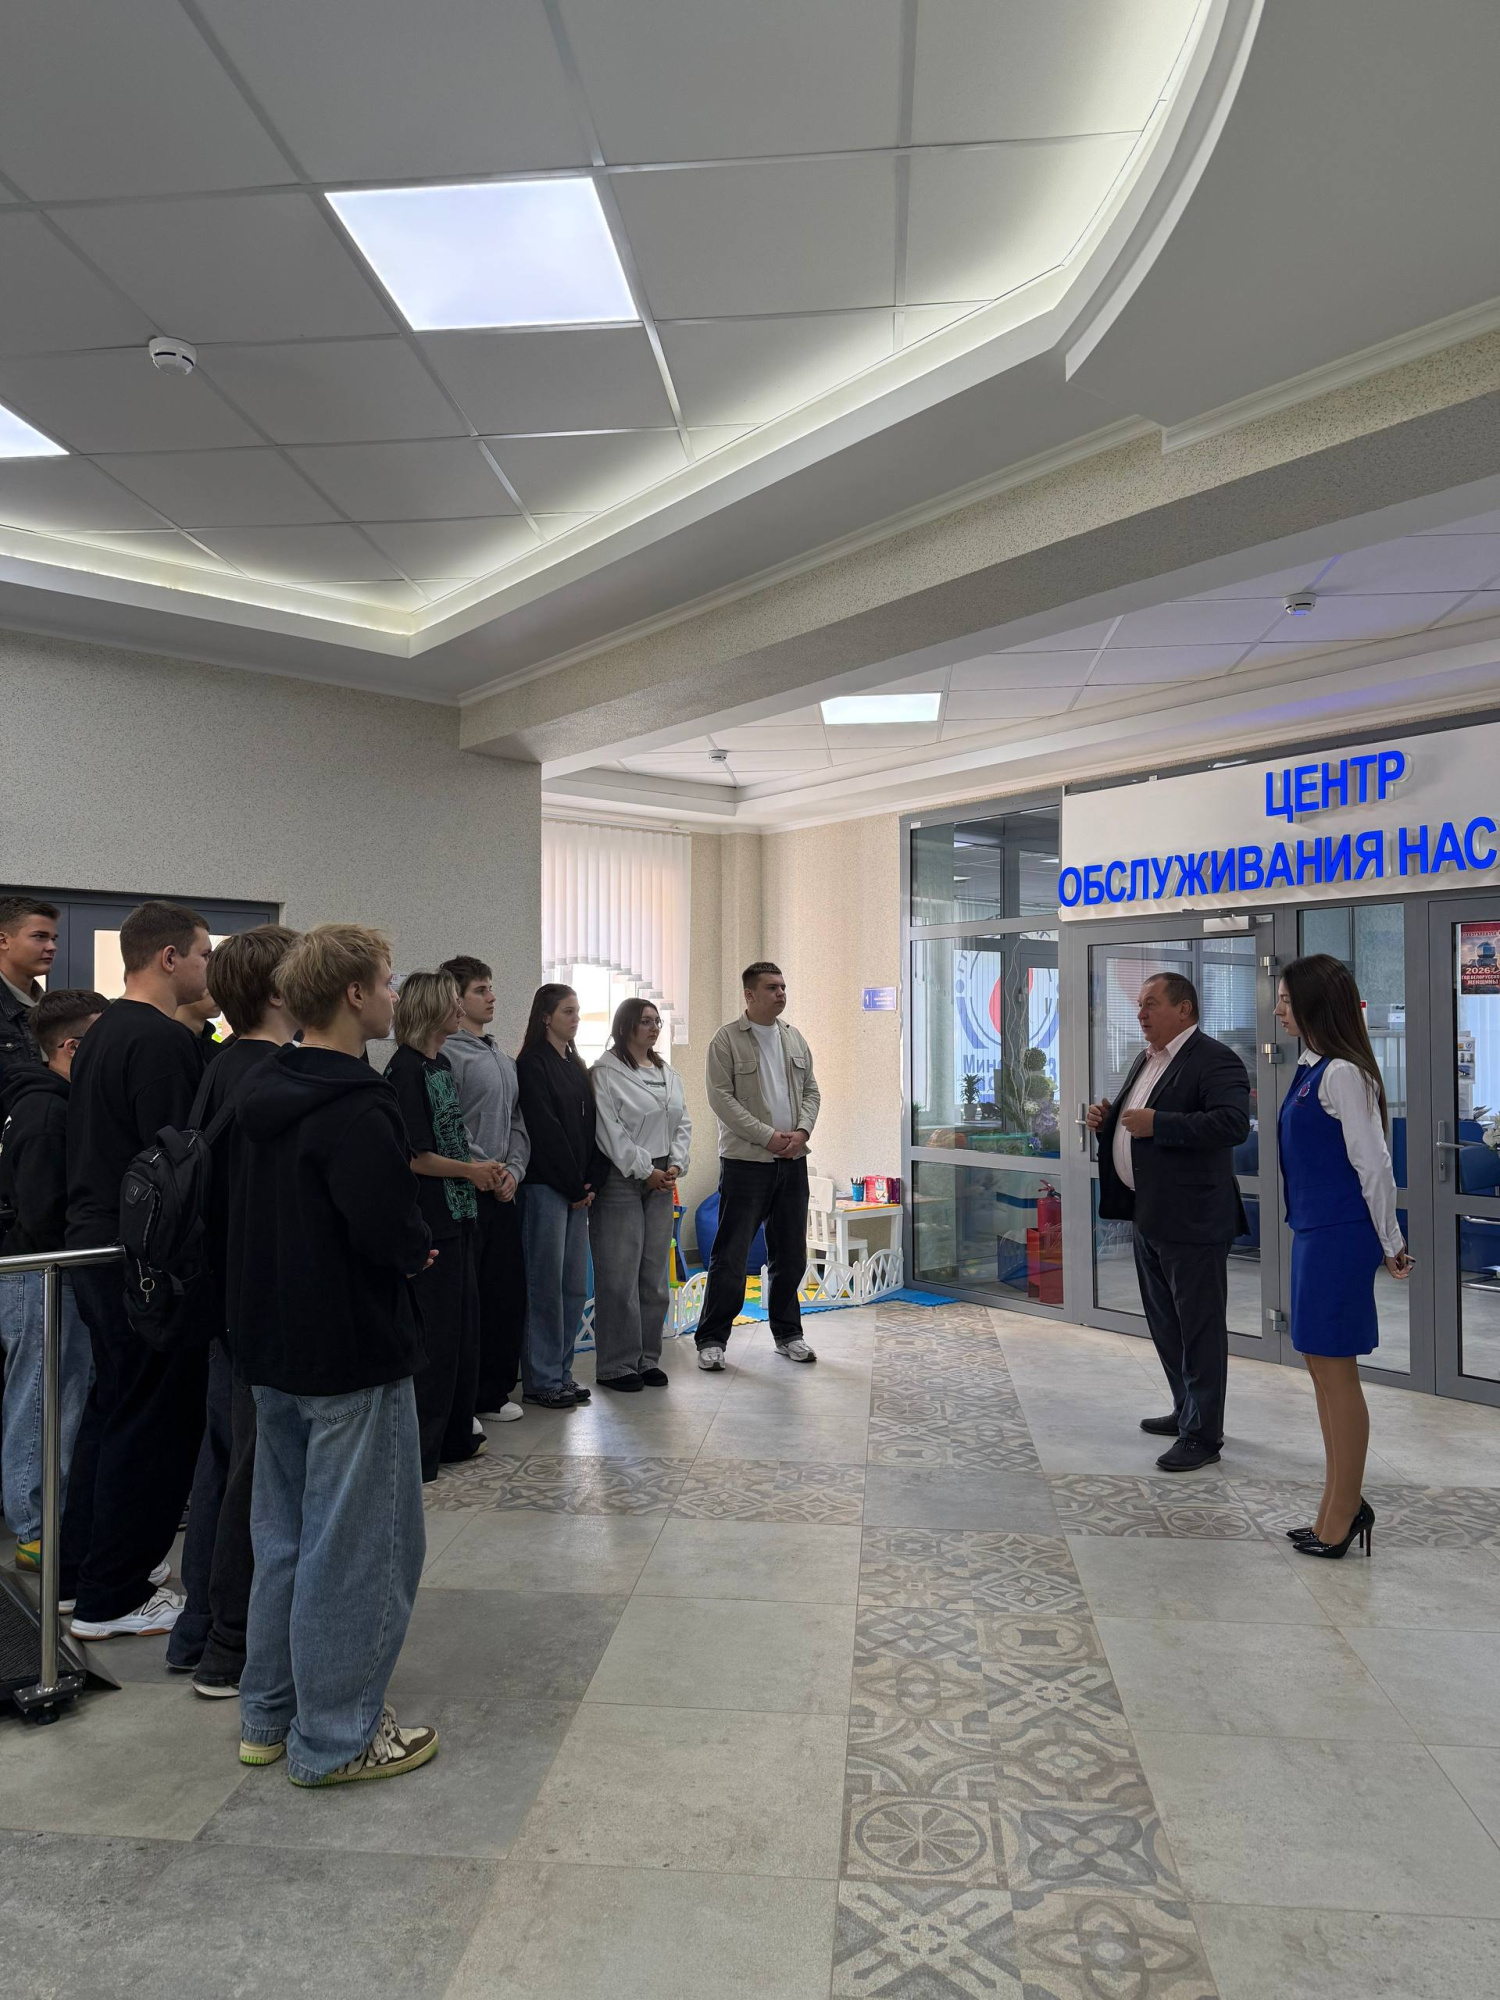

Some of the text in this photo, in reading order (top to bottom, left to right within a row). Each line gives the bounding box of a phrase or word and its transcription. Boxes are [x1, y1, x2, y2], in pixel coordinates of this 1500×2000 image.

[1265, 750, 1406, 823] ЦЕНТР
[1058, 816, 1498, 907] ОБСЛУЖИВАНИЯ НАС
[1465, 967, 1491, 975] 2026
